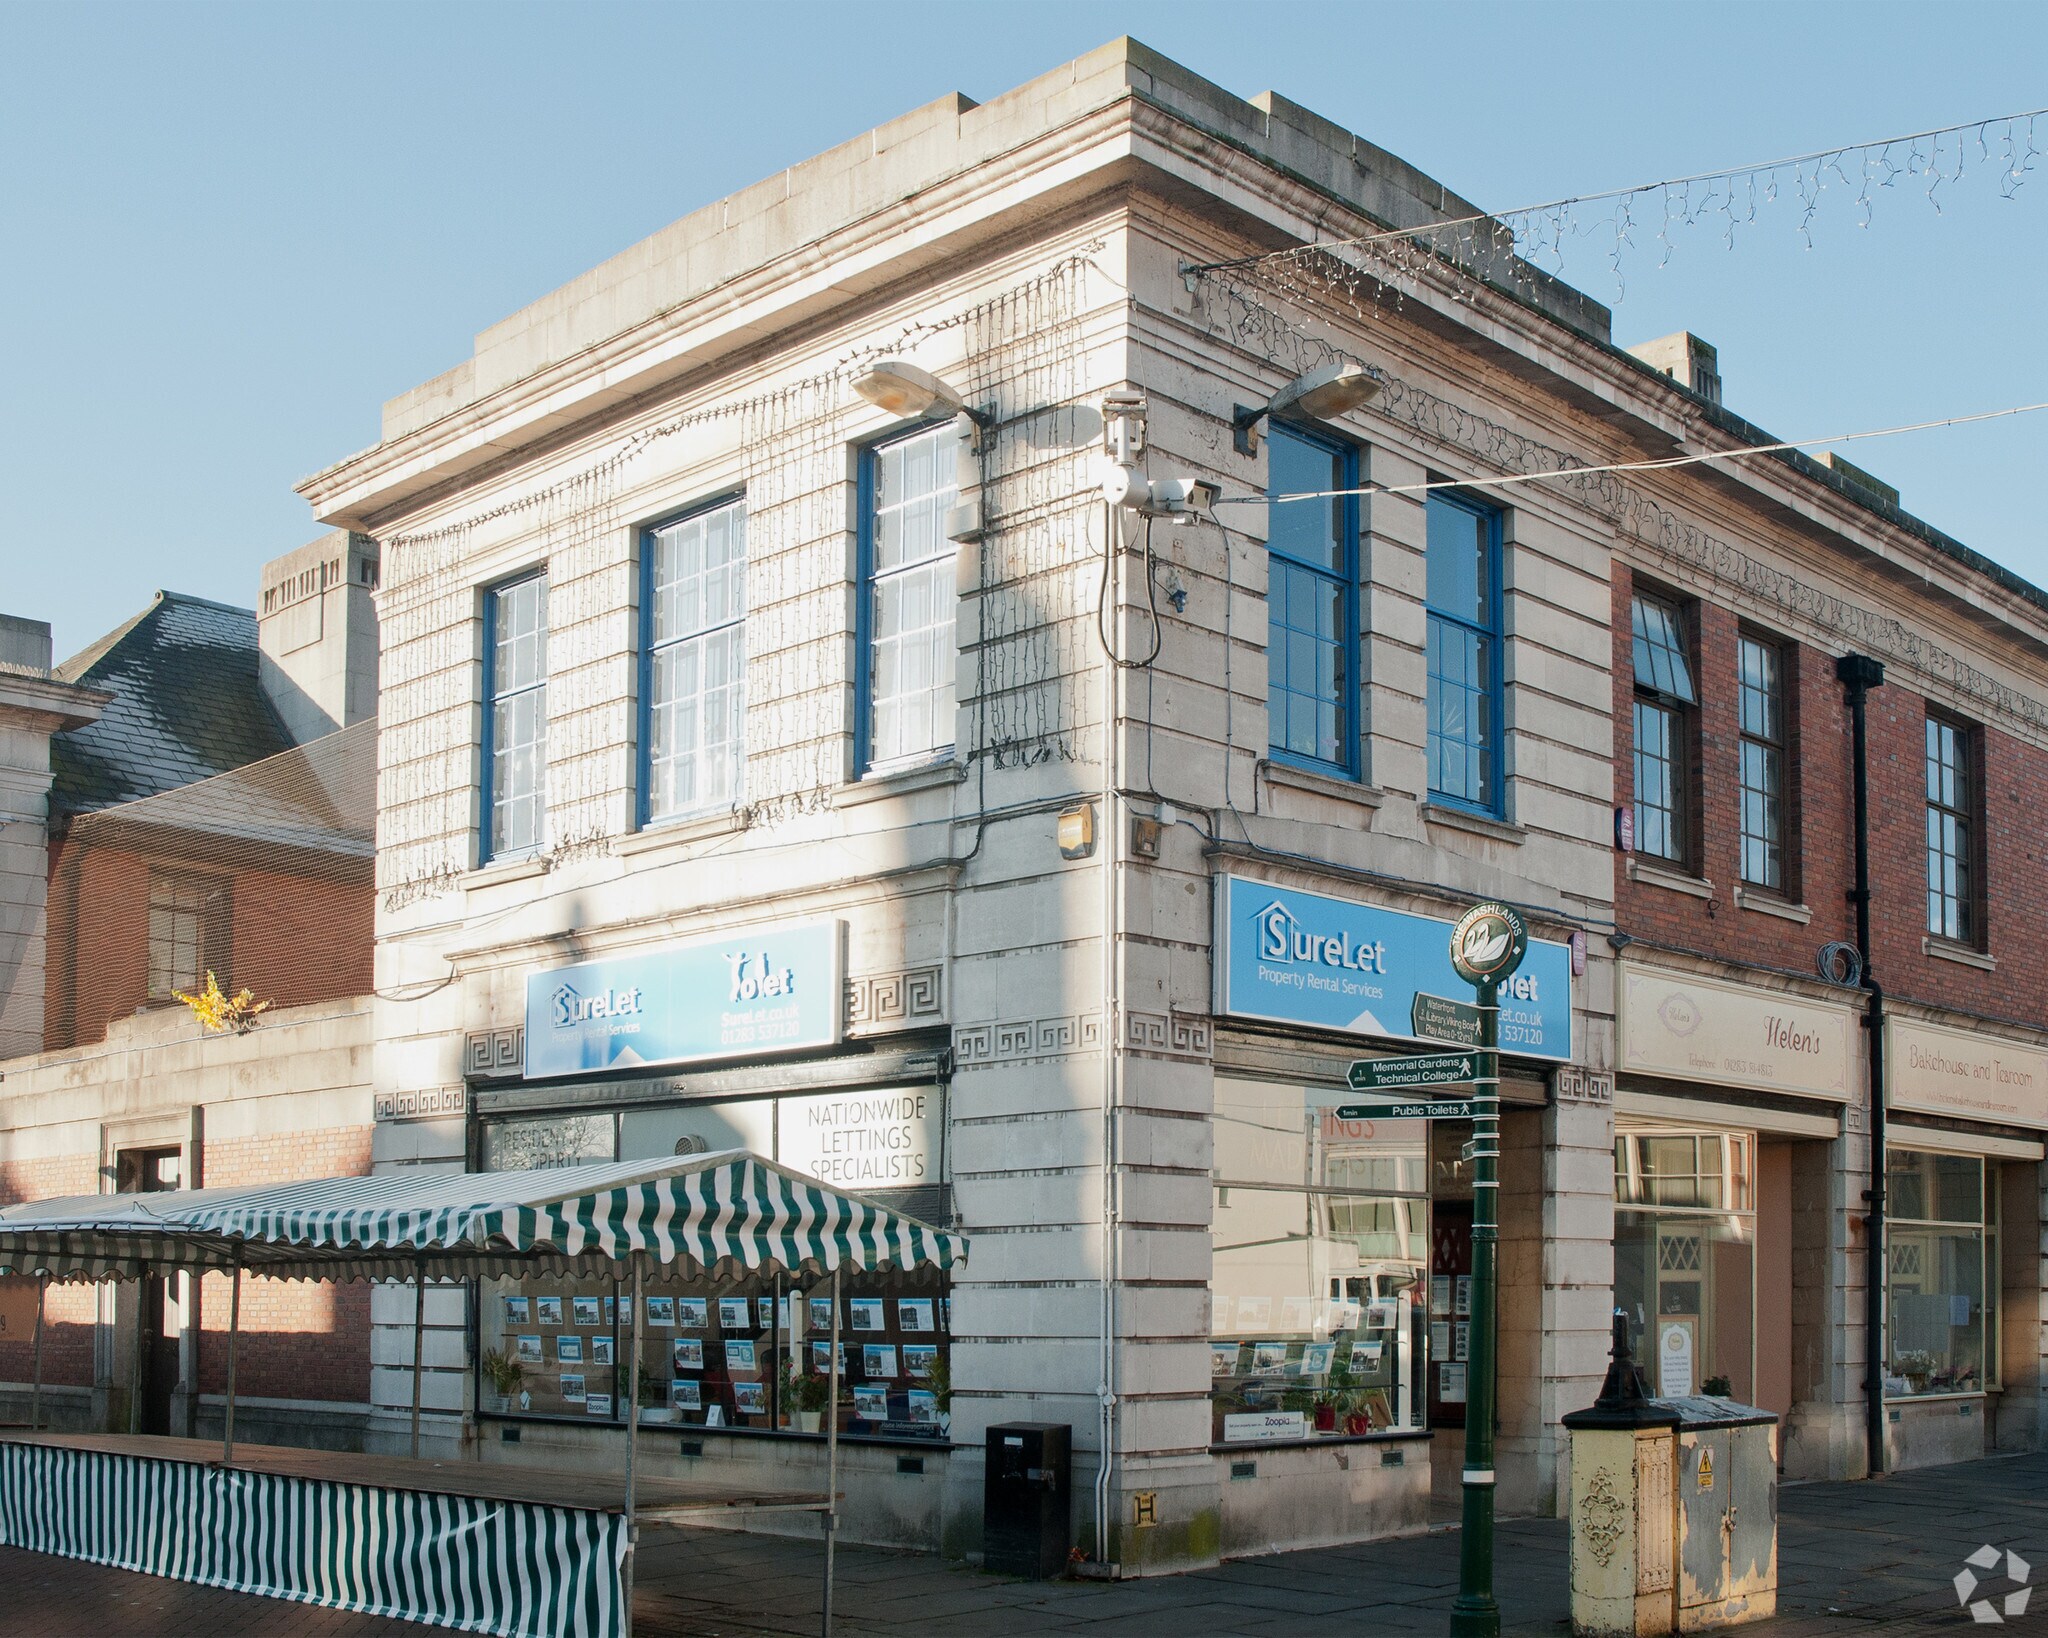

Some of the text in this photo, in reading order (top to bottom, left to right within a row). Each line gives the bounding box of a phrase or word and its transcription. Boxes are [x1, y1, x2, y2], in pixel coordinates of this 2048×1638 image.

[1453, 905, 1522, 945] THE WASHLANDS
[1264, 913, 1387, 975] SureLet
[1259, 965, 1384, 999] Property Rental Services
[553, 988, 643, 1027] SureLet
[1426, 999, 1456, 1014] Waterfront
[552, 1021, 641, 1044] Property Rental Services
[720, 1020, 799, 1045] 01283 537120
[1426, 1024, 1438, 1037] Play
[1438, 1027, 1451, 1038] Area
[1462, 1019, 1475, 1031] Boat
[1505, 1025, 1543, 1045] 537120
[1763, 1015, 1820, 1054] Helen's
[1373, 1058, 1460, 1072] Memorial Gardens
[1688, 1052, 1716, 1071] Telephone
[1723, 1057, 1747, 1073] 01283
[1909, 1043, 2034, 1088] Bakehouse and Tearoom
[1375, 1070, 1459, 1084] Technical College
[1392, 1105, 1425, 1116] Public
[1426, 1104, 1459, 1115] Toilets
[821, 1125, 912, 1153] LETTINGS
[810, 1153, 924, 1181] SPECIALISTS
